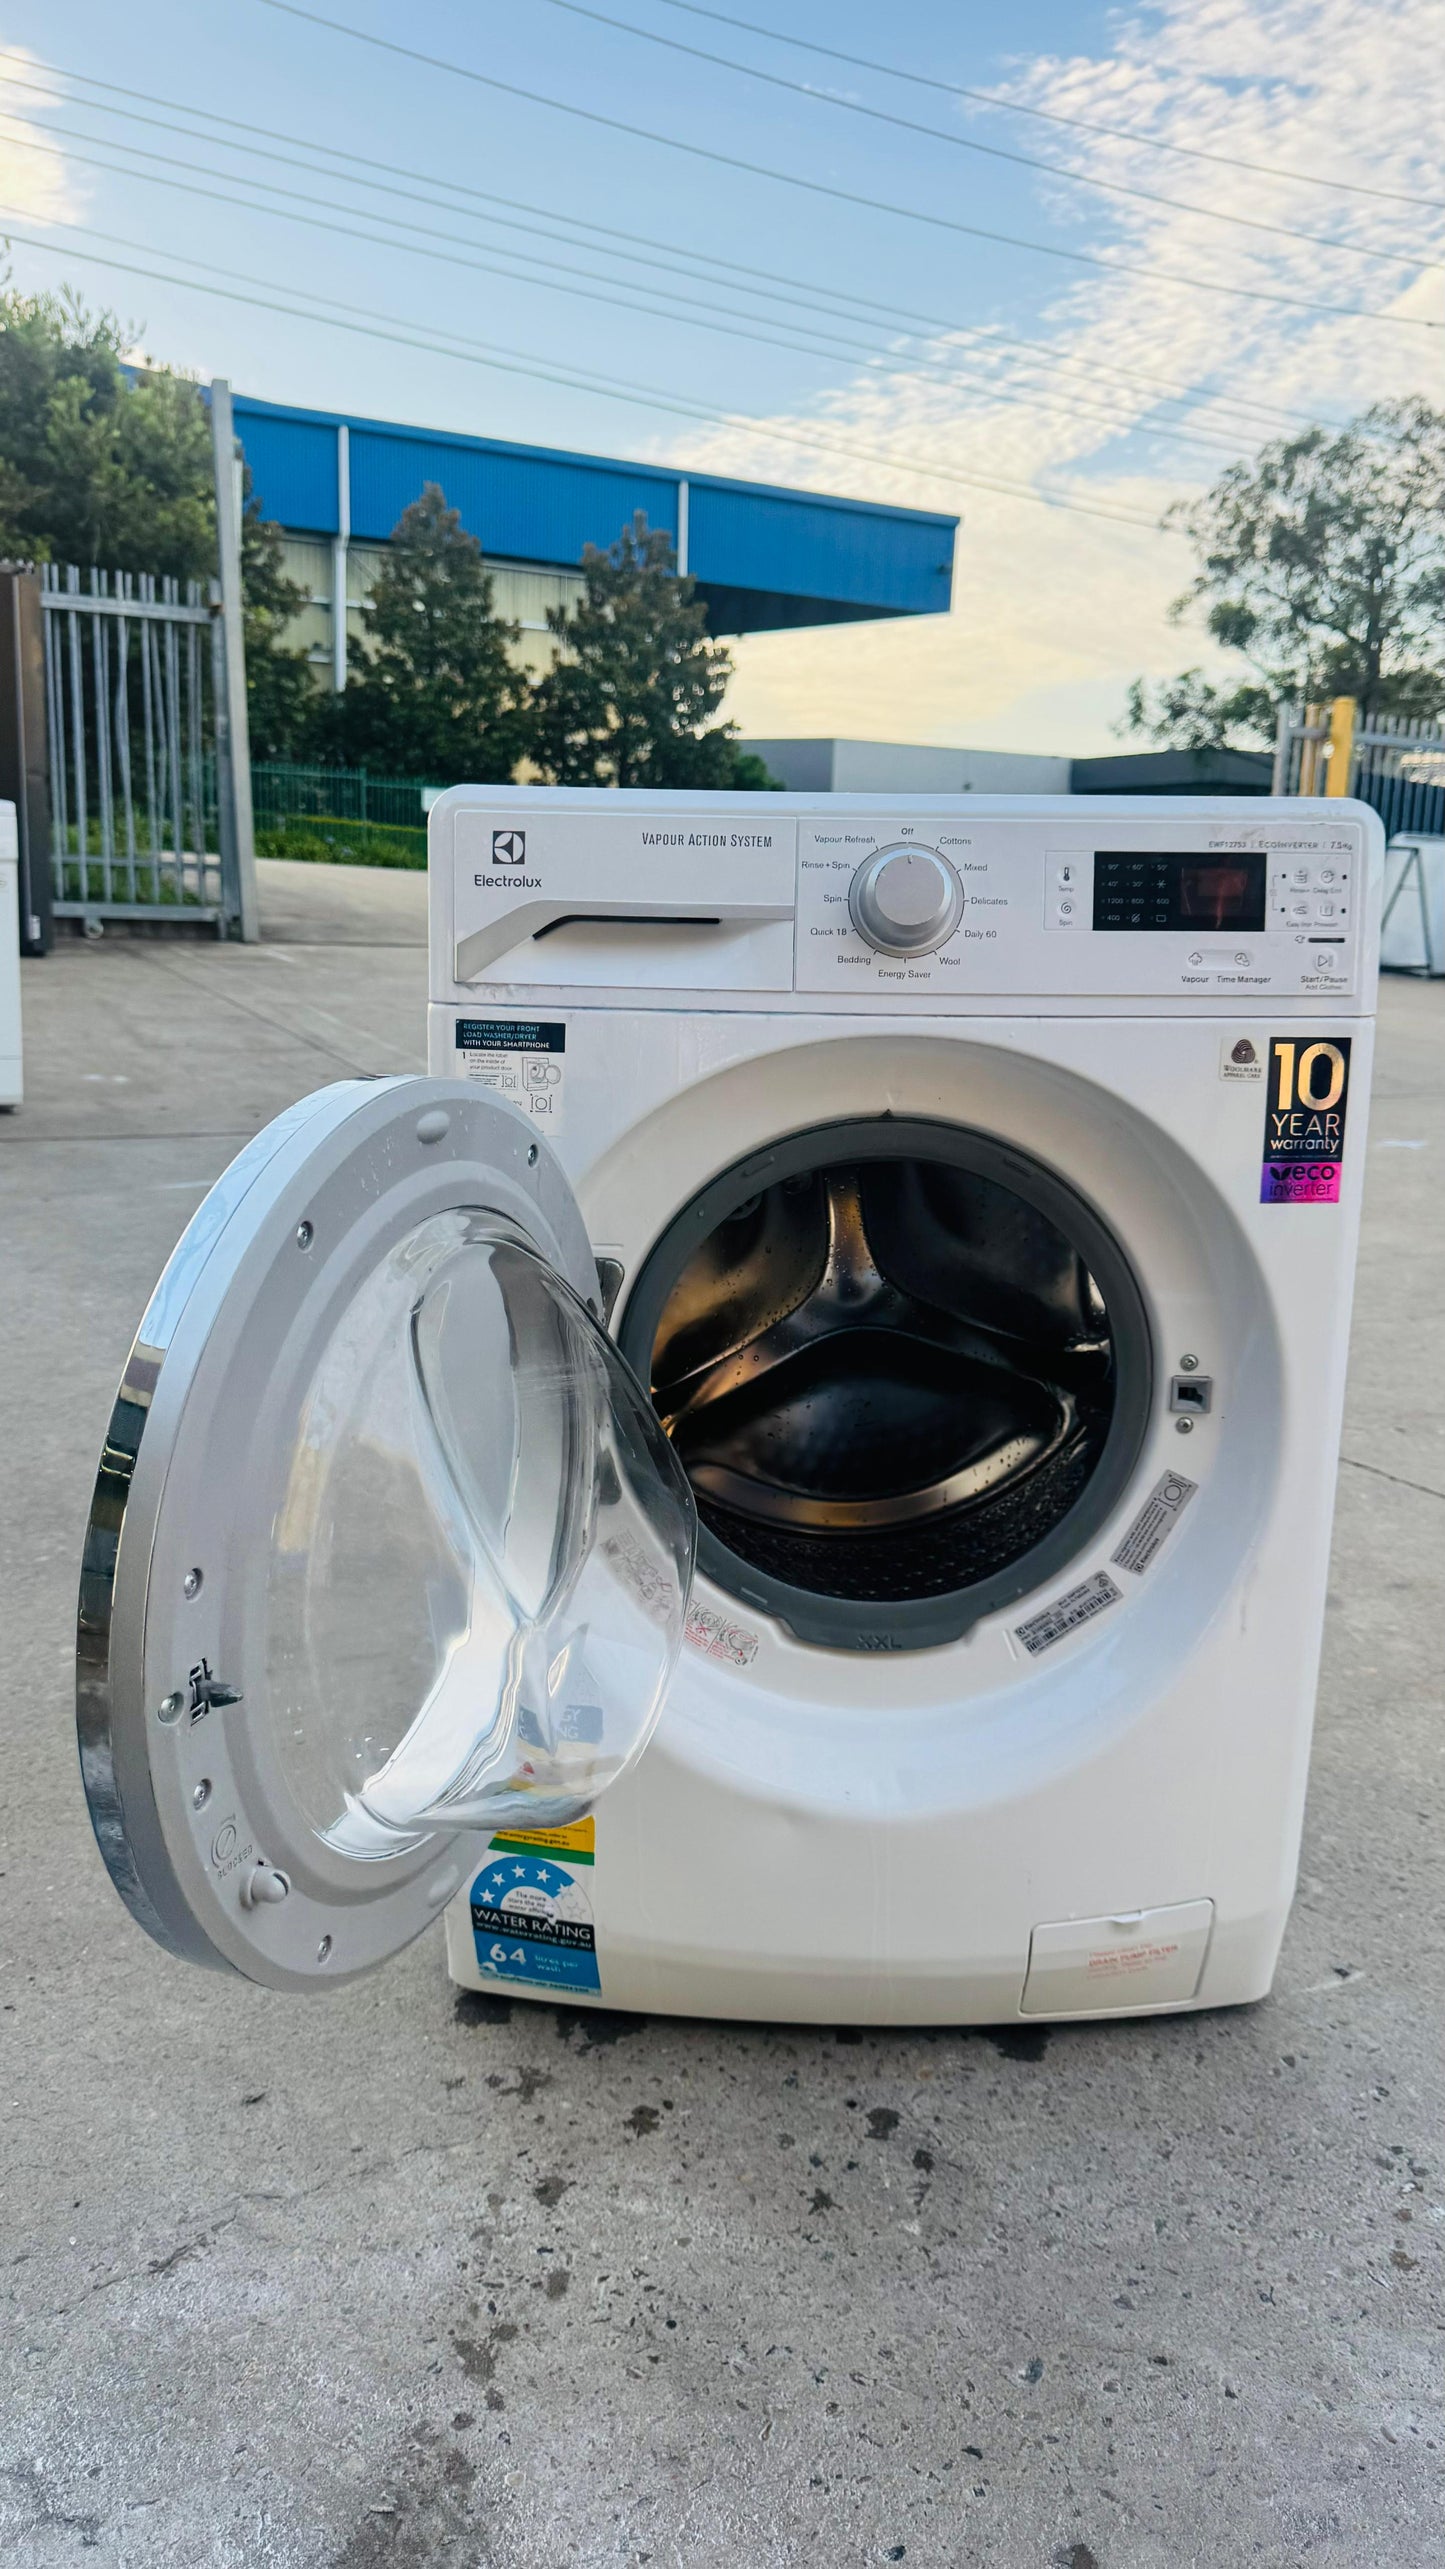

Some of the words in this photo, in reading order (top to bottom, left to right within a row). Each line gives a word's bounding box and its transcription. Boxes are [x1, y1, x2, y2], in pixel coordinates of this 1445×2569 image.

[901, 827, 914, 835] Off
[642, 832, 684, 846] VAPOUR
[688, 833, 727, 847] ACTION
[730, 834, 772, 847] SYSTEM
[814, 835, 842, 844] Vapour
[845, 835, 876, 844] Refresh
[940, 836, 972, 845] Cottons
[801, 861, 824, 869] Rinse
[831, 861, 850, 870] Spin
[964, 863, 988, 871] Mixed
[474, 874, 542, 888] Electrolux
[823, 894, 842, 903] Spin
[970, 896, 1008, 905] Delicates
[810, 928, 834, 936] Quick
[837, 928, 847, 936] 18
[964, 930, 983, 940] Daily
[837, 955, 871, 965] Bedding
[939, 957, 961, 966] Wool
[878, 969, 906, 980] Energy
[908, 970, 931, 979] Saver
[1181, 976, 1209, 984] Vapour
[1237, 976, 1272, 985] Manager
[463, 1023, 495, 1031] REGISTER
[516, 1025, 540, 1033] FRONT
[483, 1032, 537, 1040] WASHER/DRYER
[503, 1041, 550, 1049] SMARTPHONE
[1275, 1042, 1345, 1111] 10
[1271, 1113, 1340, 1137] YEAR
[1270, 1136, 1339, 1153] warranty
[1292, 1165, 1335, 1181] eco
[1269, 1181, 1334, 1196] inverter
[856, 1632, 902, 1649] XXL
[473, 1908, 528, 1929] WATER
[531, 1919, 591, 1940] RATING
[476, 1922, 591, 1949] www.waterrating.gov.au
[490, 1943, 527, 1965] 64
[537, 1962, 560, 1973] wash
